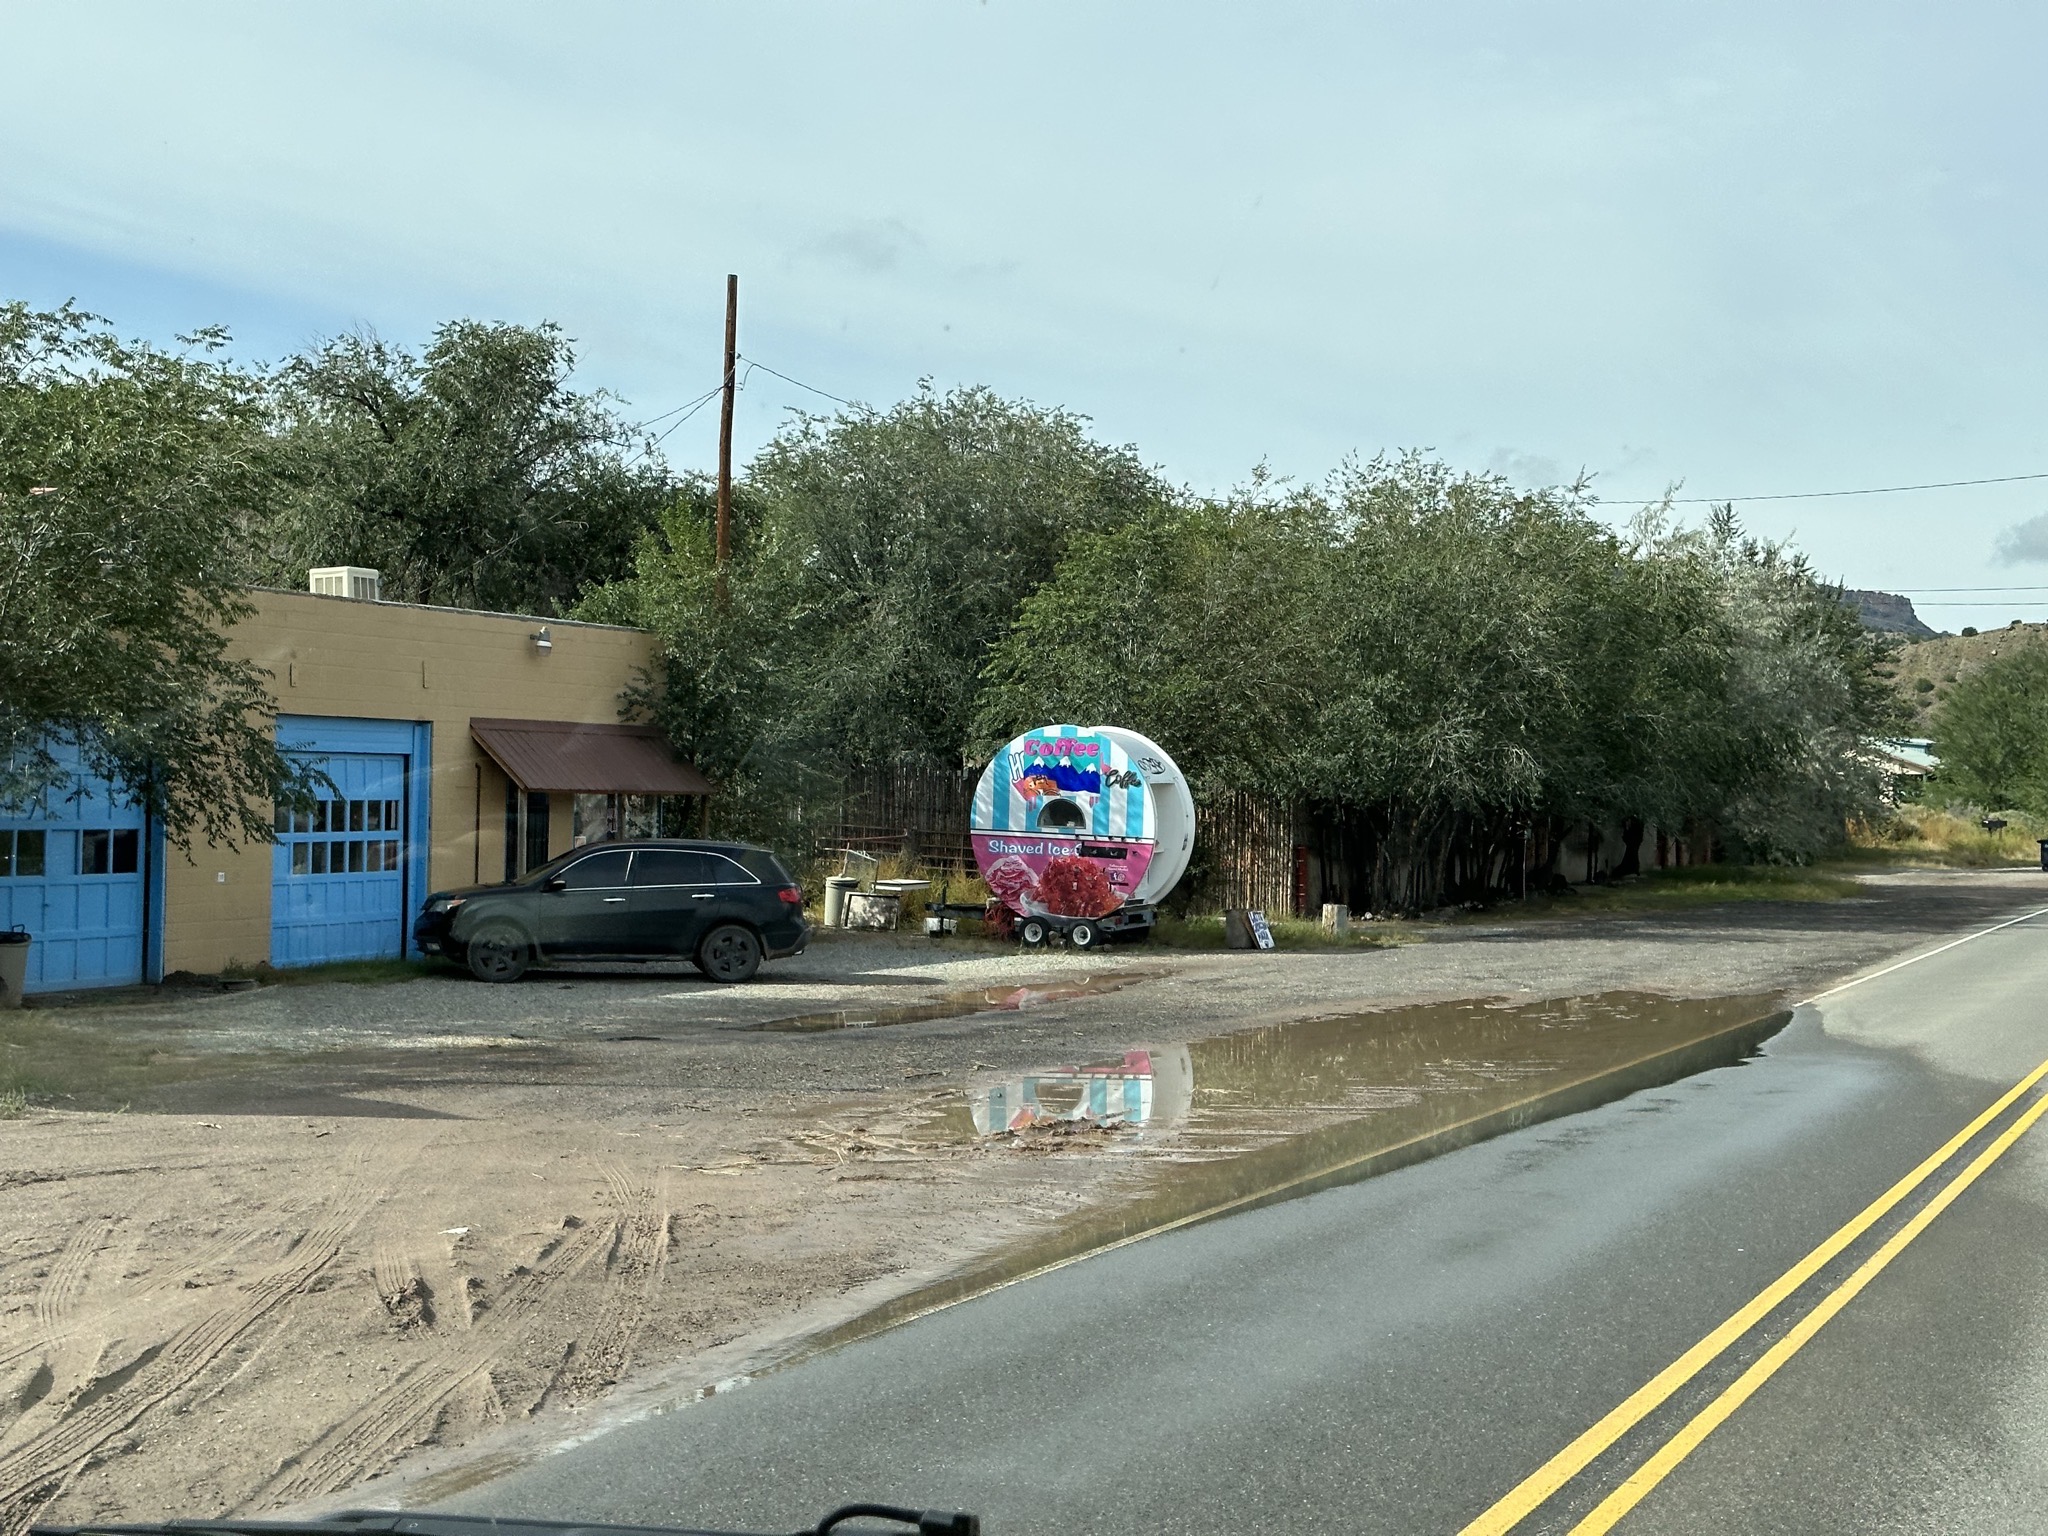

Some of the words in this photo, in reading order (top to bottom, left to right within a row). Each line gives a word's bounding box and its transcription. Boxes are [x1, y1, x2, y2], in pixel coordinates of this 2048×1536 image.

[1024, 738, 1099, 757] Coffee
[988, 840, 1043, 854] Shaved
[1048, 842, 1070, 856] Ice
